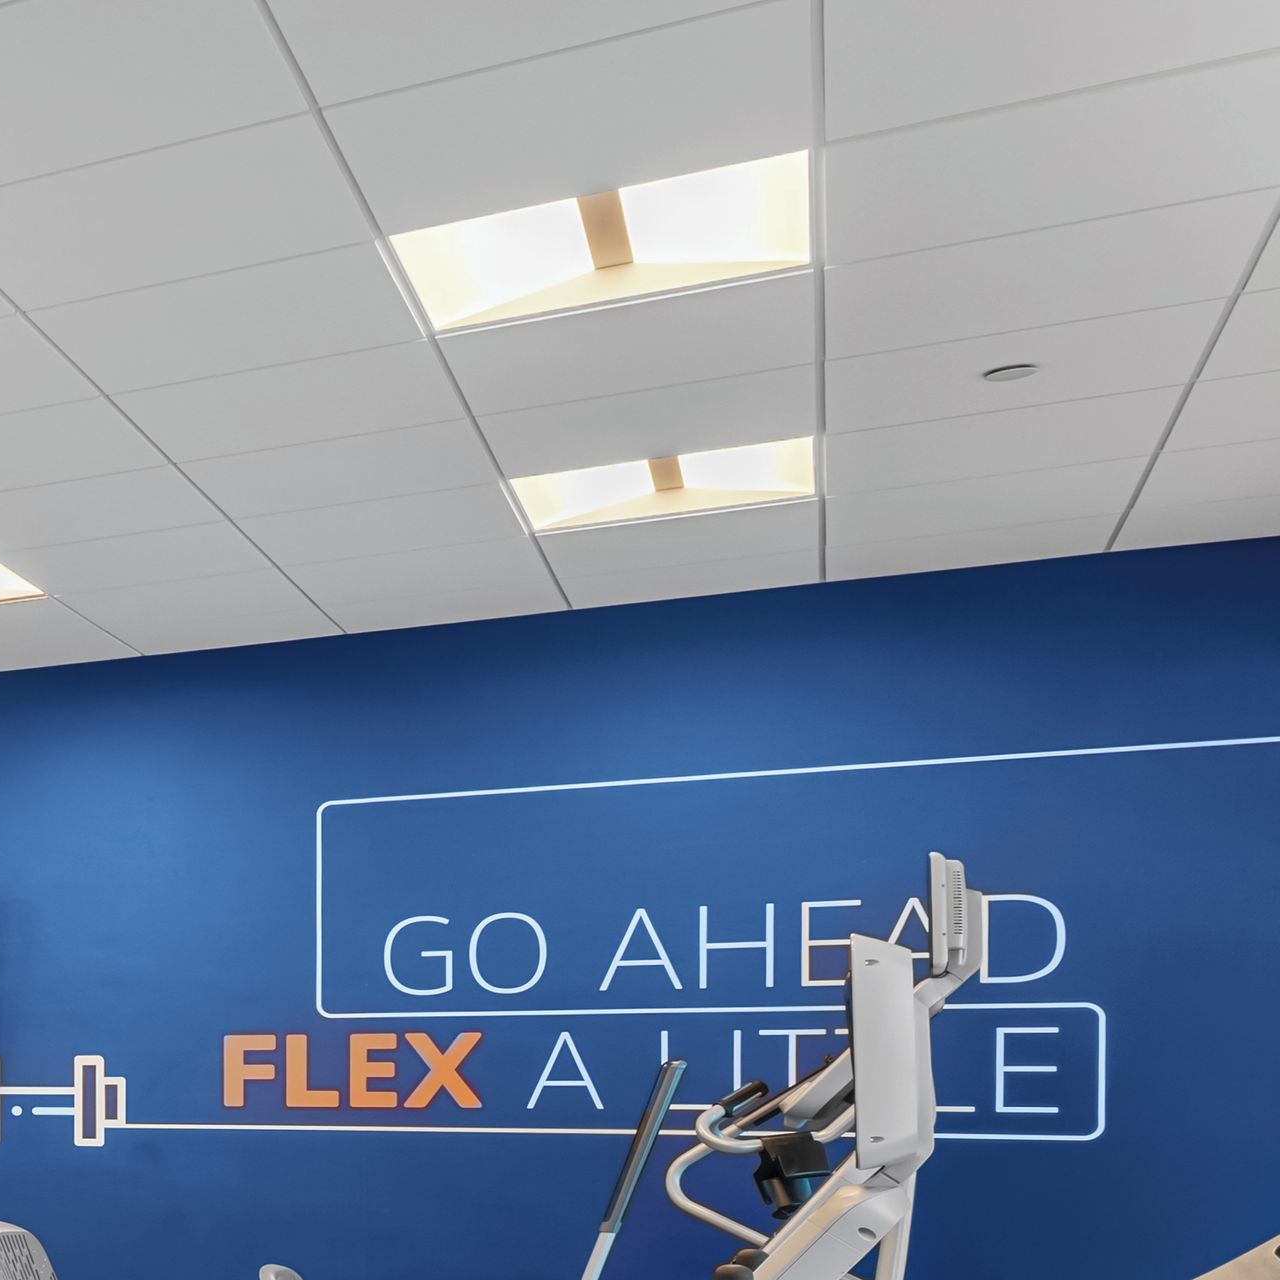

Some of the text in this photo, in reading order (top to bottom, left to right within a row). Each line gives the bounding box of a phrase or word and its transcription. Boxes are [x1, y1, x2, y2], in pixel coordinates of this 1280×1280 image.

[383, 912, 548, 997] GO
[223, 1027, 1060, 1113] FLEX A LITE
